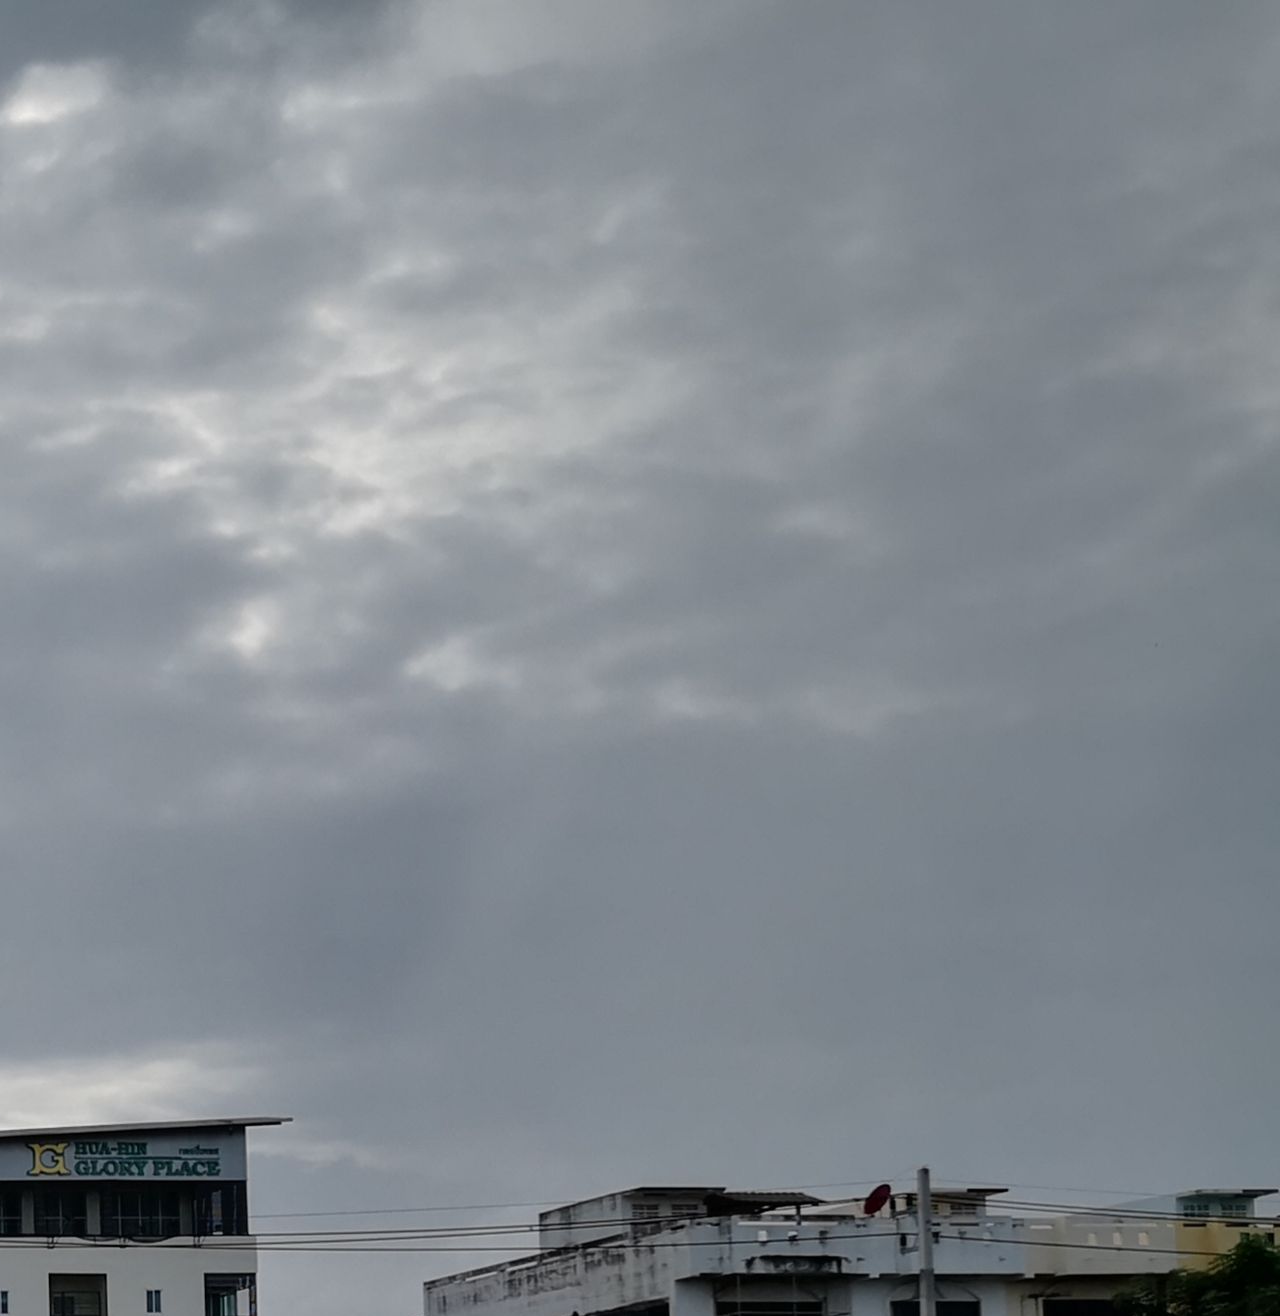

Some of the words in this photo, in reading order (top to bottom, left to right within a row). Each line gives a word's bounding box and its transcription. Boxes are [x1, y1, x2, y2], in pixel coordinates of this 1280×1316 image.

[74, 1141, 148, 1155] HUA-HIN
[74, 1160, 148, 1176] GLORY
[153, 1160, 220, 1176] PLACE
